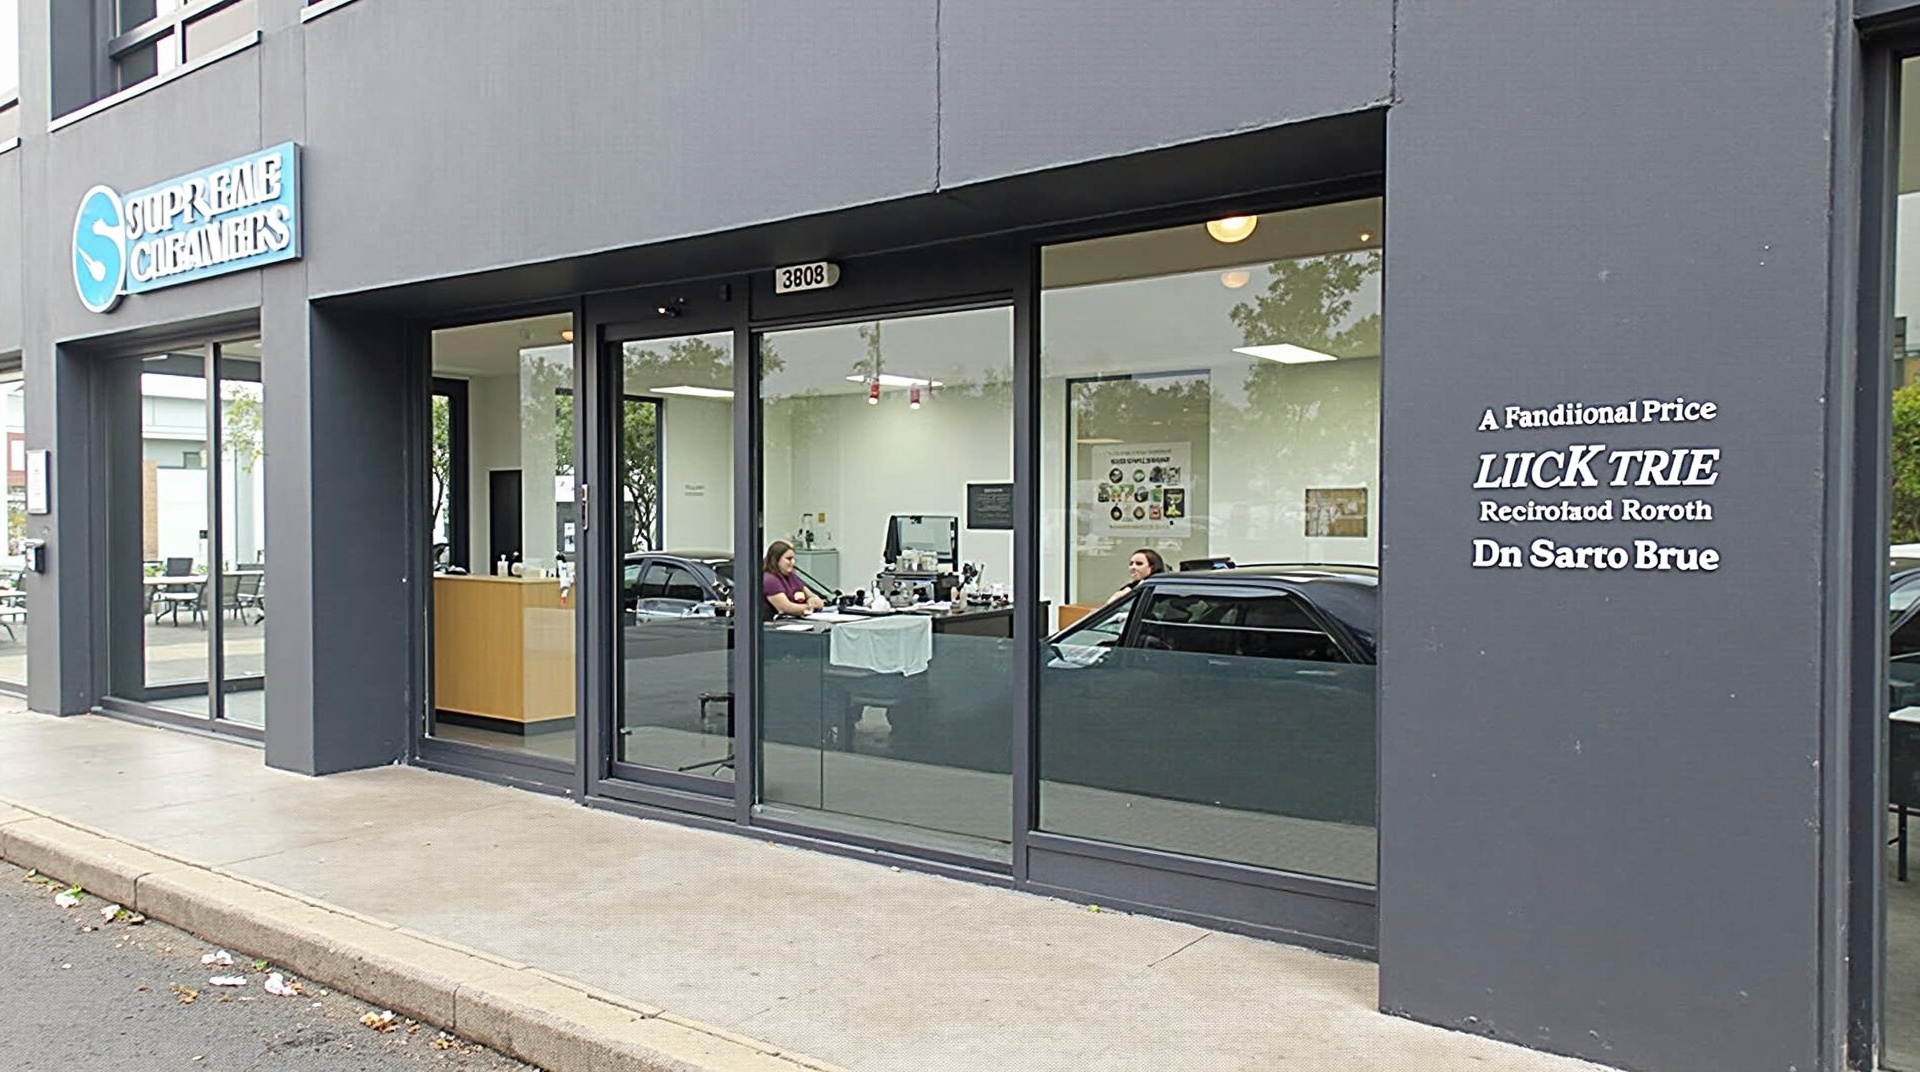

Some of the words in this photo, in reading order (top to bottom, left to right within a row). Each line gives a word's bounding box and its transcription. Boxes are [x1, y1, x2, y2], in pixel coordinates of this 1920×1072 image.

[783, 265, 824, 288] 3808
[1478, 409, 1499, 431] A
[1641, 397, 1717, 423] Price
[1608, 449, 1720, 487] TRIE
[1621, 499, 1712, 521] Roroth
[1472, 539, 1523, 568] Dn
[1634, 540, 1719, 571] Brue
